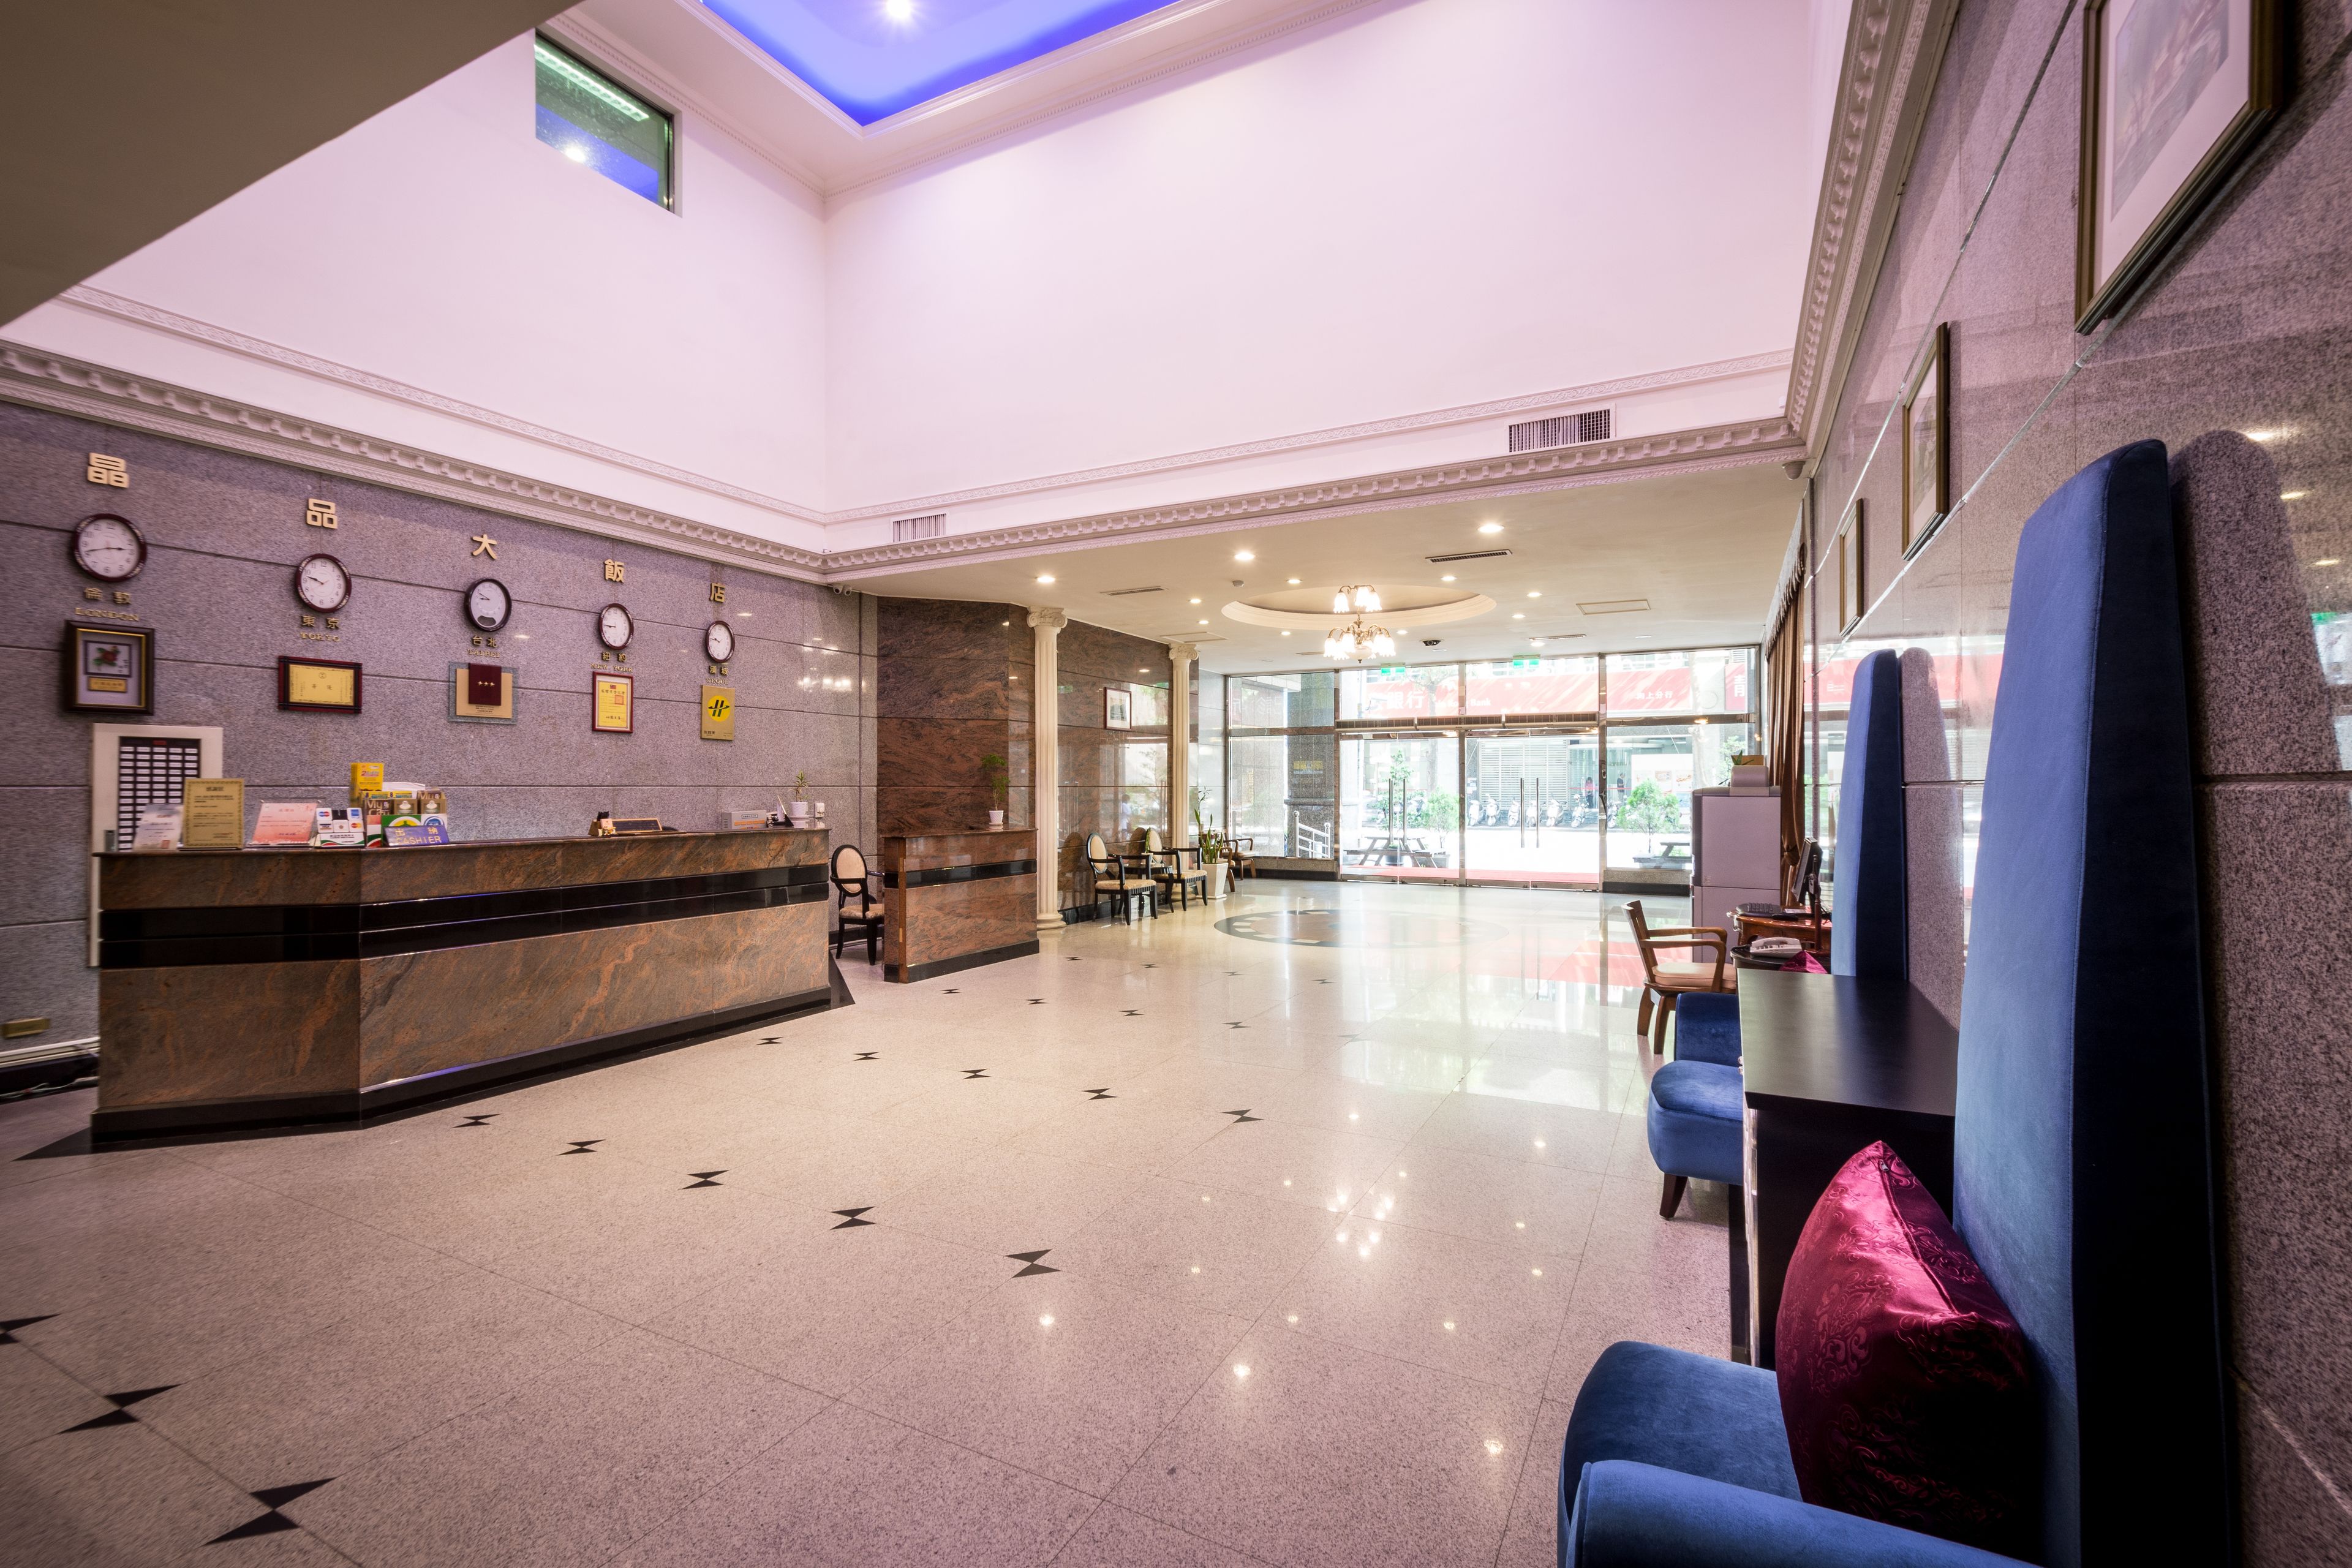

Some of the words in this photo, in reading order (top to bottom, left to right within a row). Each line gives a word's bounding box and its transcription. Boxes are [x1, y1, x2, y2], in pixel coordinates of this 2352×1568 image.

[75, 607, 140, 622] LONDON
[302, 615, 339, 629] 東京
[300, 632, 340, 643] TOKYO
[472, 635, 497, 647] 台北
[467, 649, 500, 658] TAIPEI
[602, 652, 627, 662] 紐約
[394, 826, 439, 836] 出納
[396, 836, 442, 845] CASHIER
